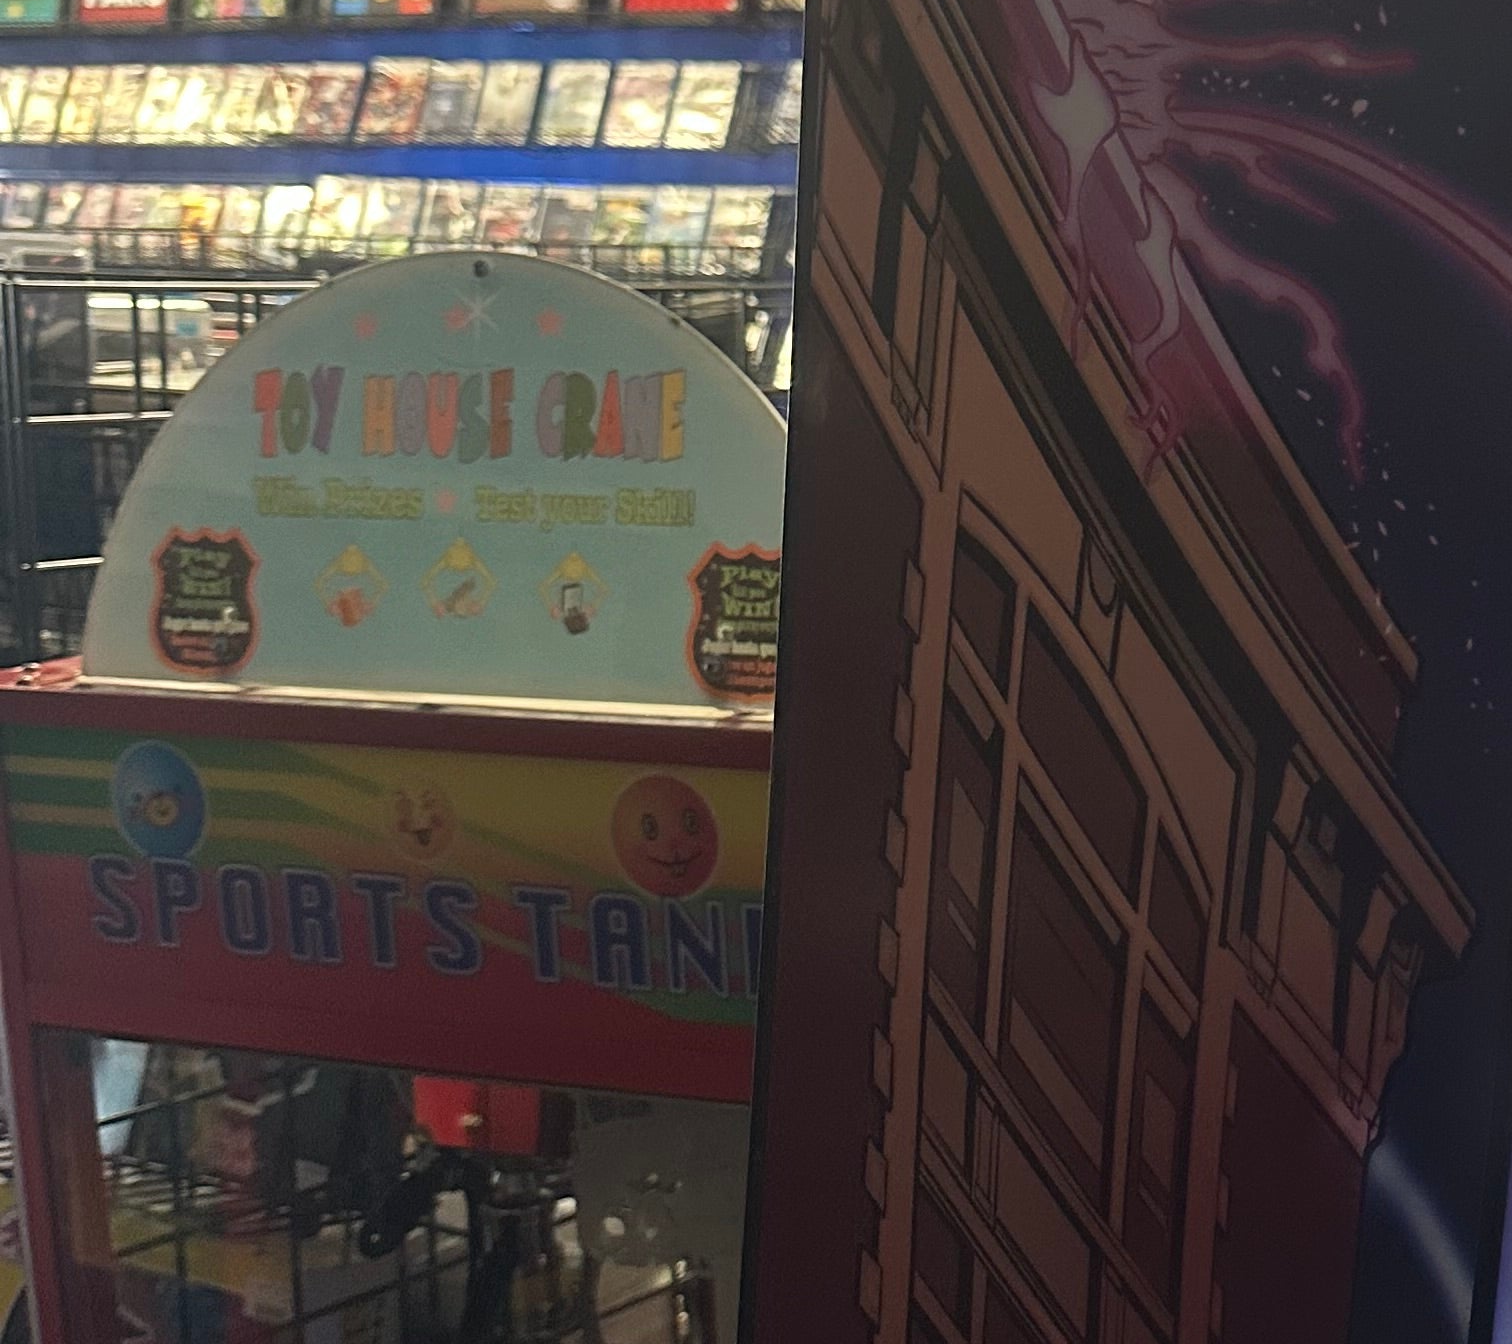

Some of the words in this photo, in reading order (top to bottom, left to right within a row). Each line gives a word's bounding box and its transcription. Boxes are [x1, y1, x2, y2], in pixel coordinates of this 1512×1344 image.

[253, 365, 345, 458] TOY
[362, 368, 515, 464] HOUSE
[535, 368, 687, 463] CRANE
[87, 855, 483, 976] SPORTS
